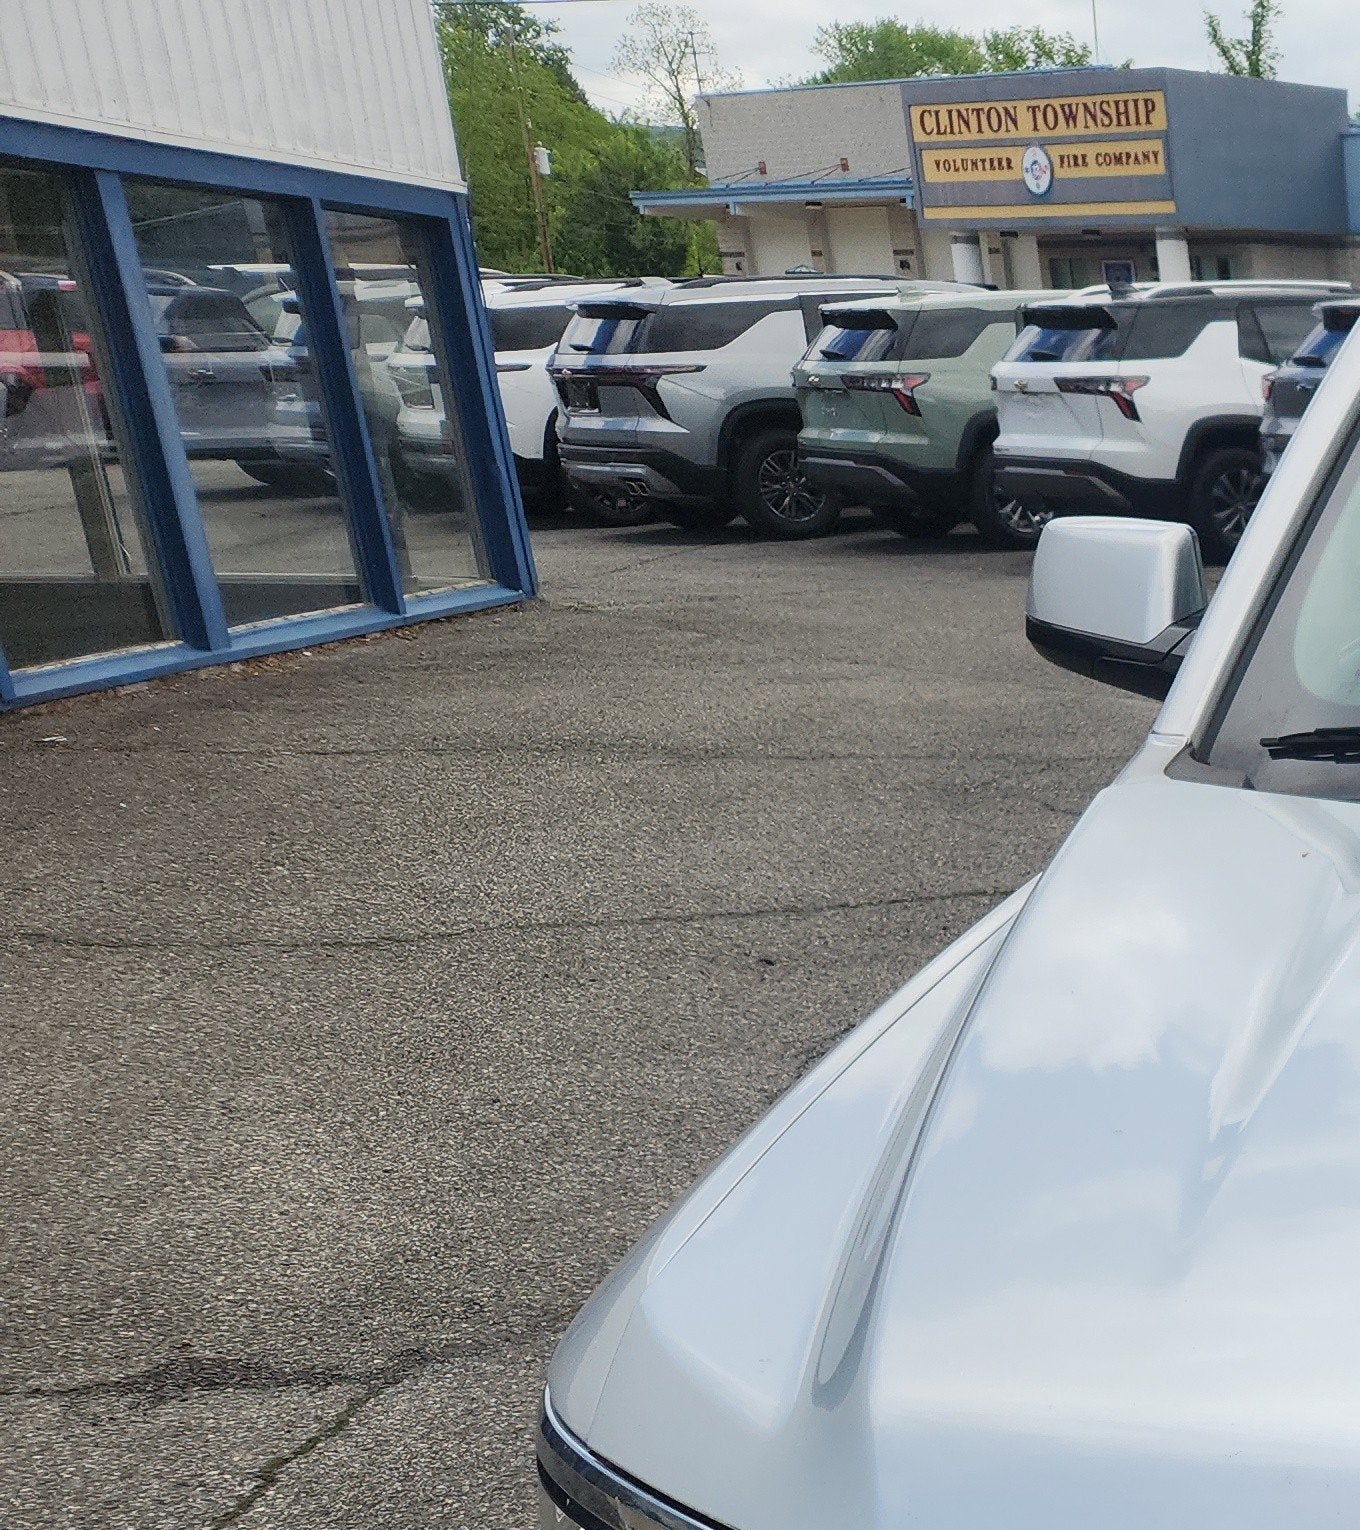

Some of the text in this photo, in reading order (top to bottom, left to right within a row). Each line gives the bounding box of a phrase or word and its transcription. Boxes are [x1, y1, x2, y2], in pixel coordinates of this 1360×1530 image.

[919, 97, 1157, 136] CLINTON TOWNSHIP
[934, 149, 1160, 173] VOLUNTEER FIRE COMPANY
